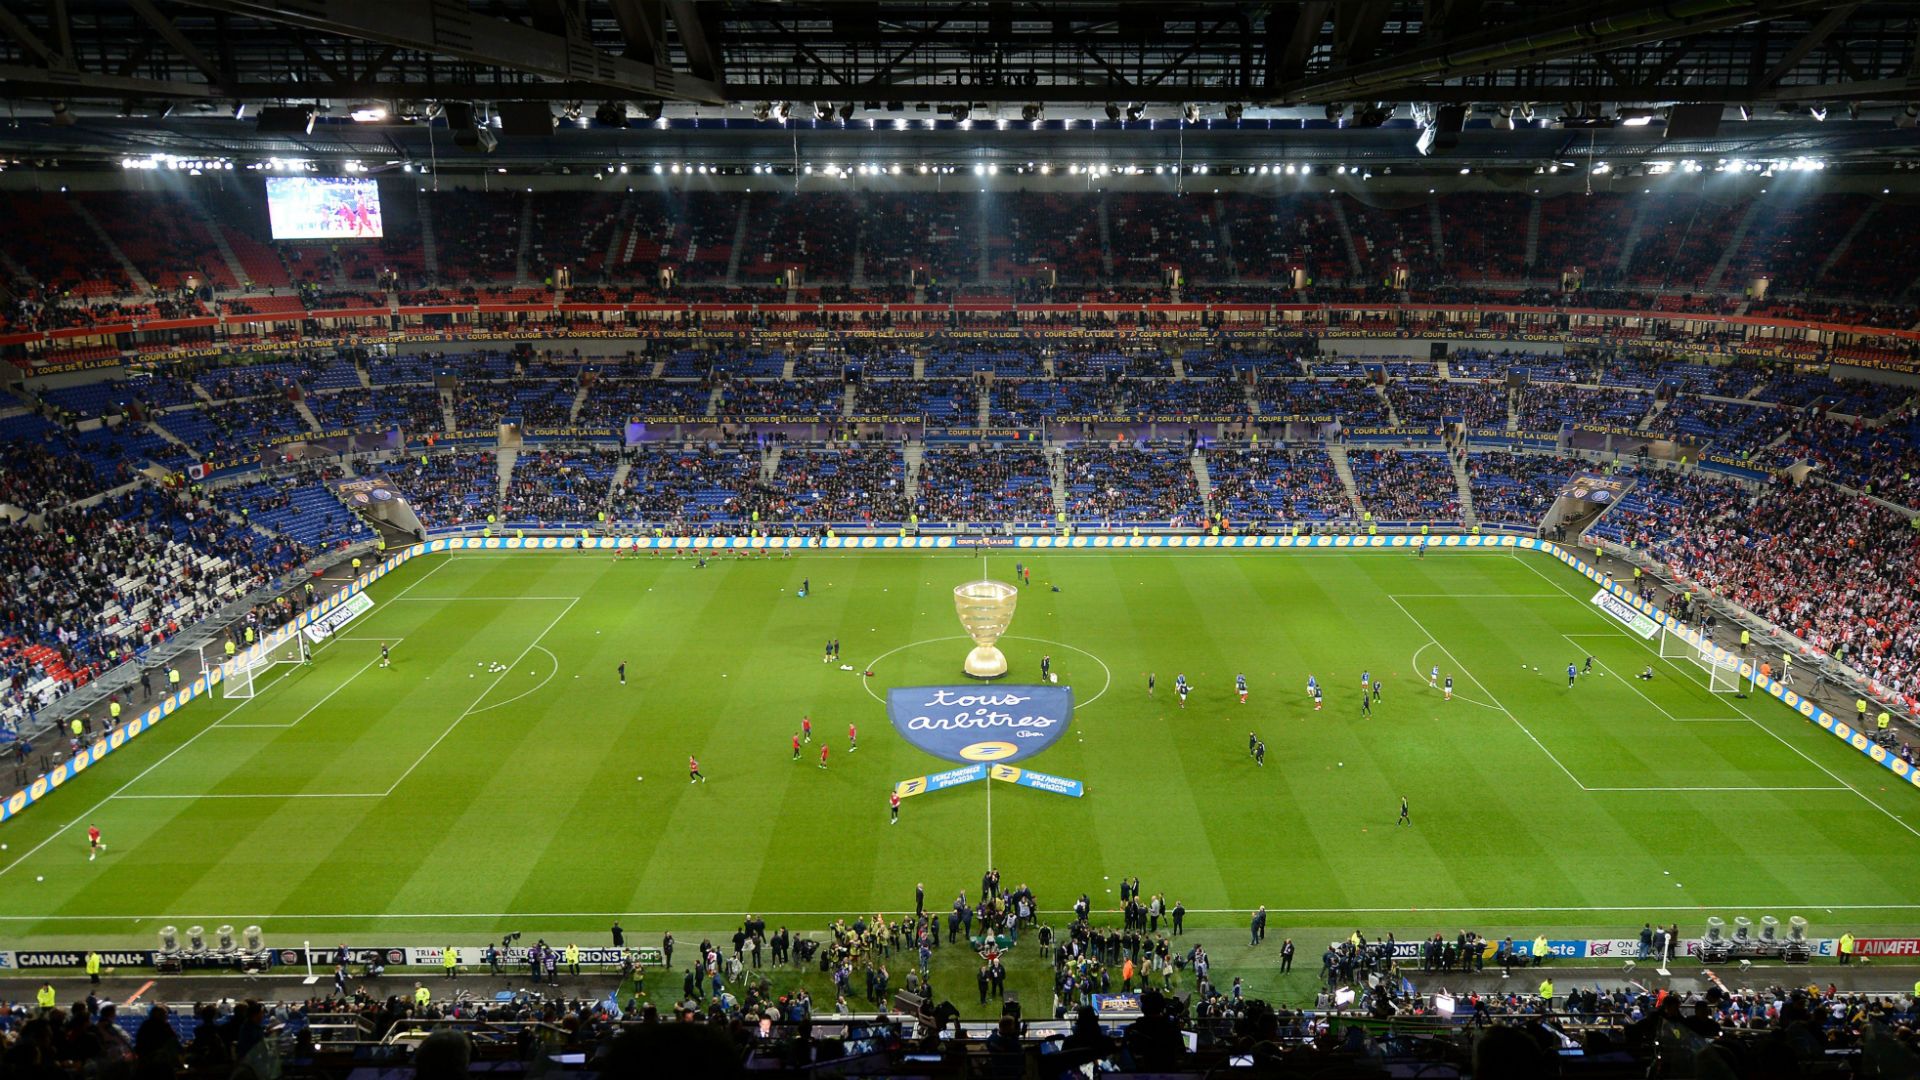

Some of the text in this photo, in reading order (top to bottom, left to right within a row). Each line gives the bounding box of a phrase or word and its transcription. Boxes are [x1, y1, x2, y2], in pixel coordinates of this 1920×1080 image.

[251, 343, 278, 352] COUPE
[311, 340, 333, 348] LIGUE
[138, 348, 222, 362] COUPE DE LA LIGUE
[1736, 348, 1761, 356] COUPE
[1794, 352, 1816, 361] LIGUE
[38, 358, 120, 374] COUPE DE LA LIGUE
[1834, 356, 1860, 366] COUPE
[1880, 362, 1890, 370] LA
[1892, 364, 1914, 373] LIGUE
[924, 690, 1030, 707] tous
[908, 708, 1057, 730] arbitres
[19, 955, 79, 965] CANAL+
